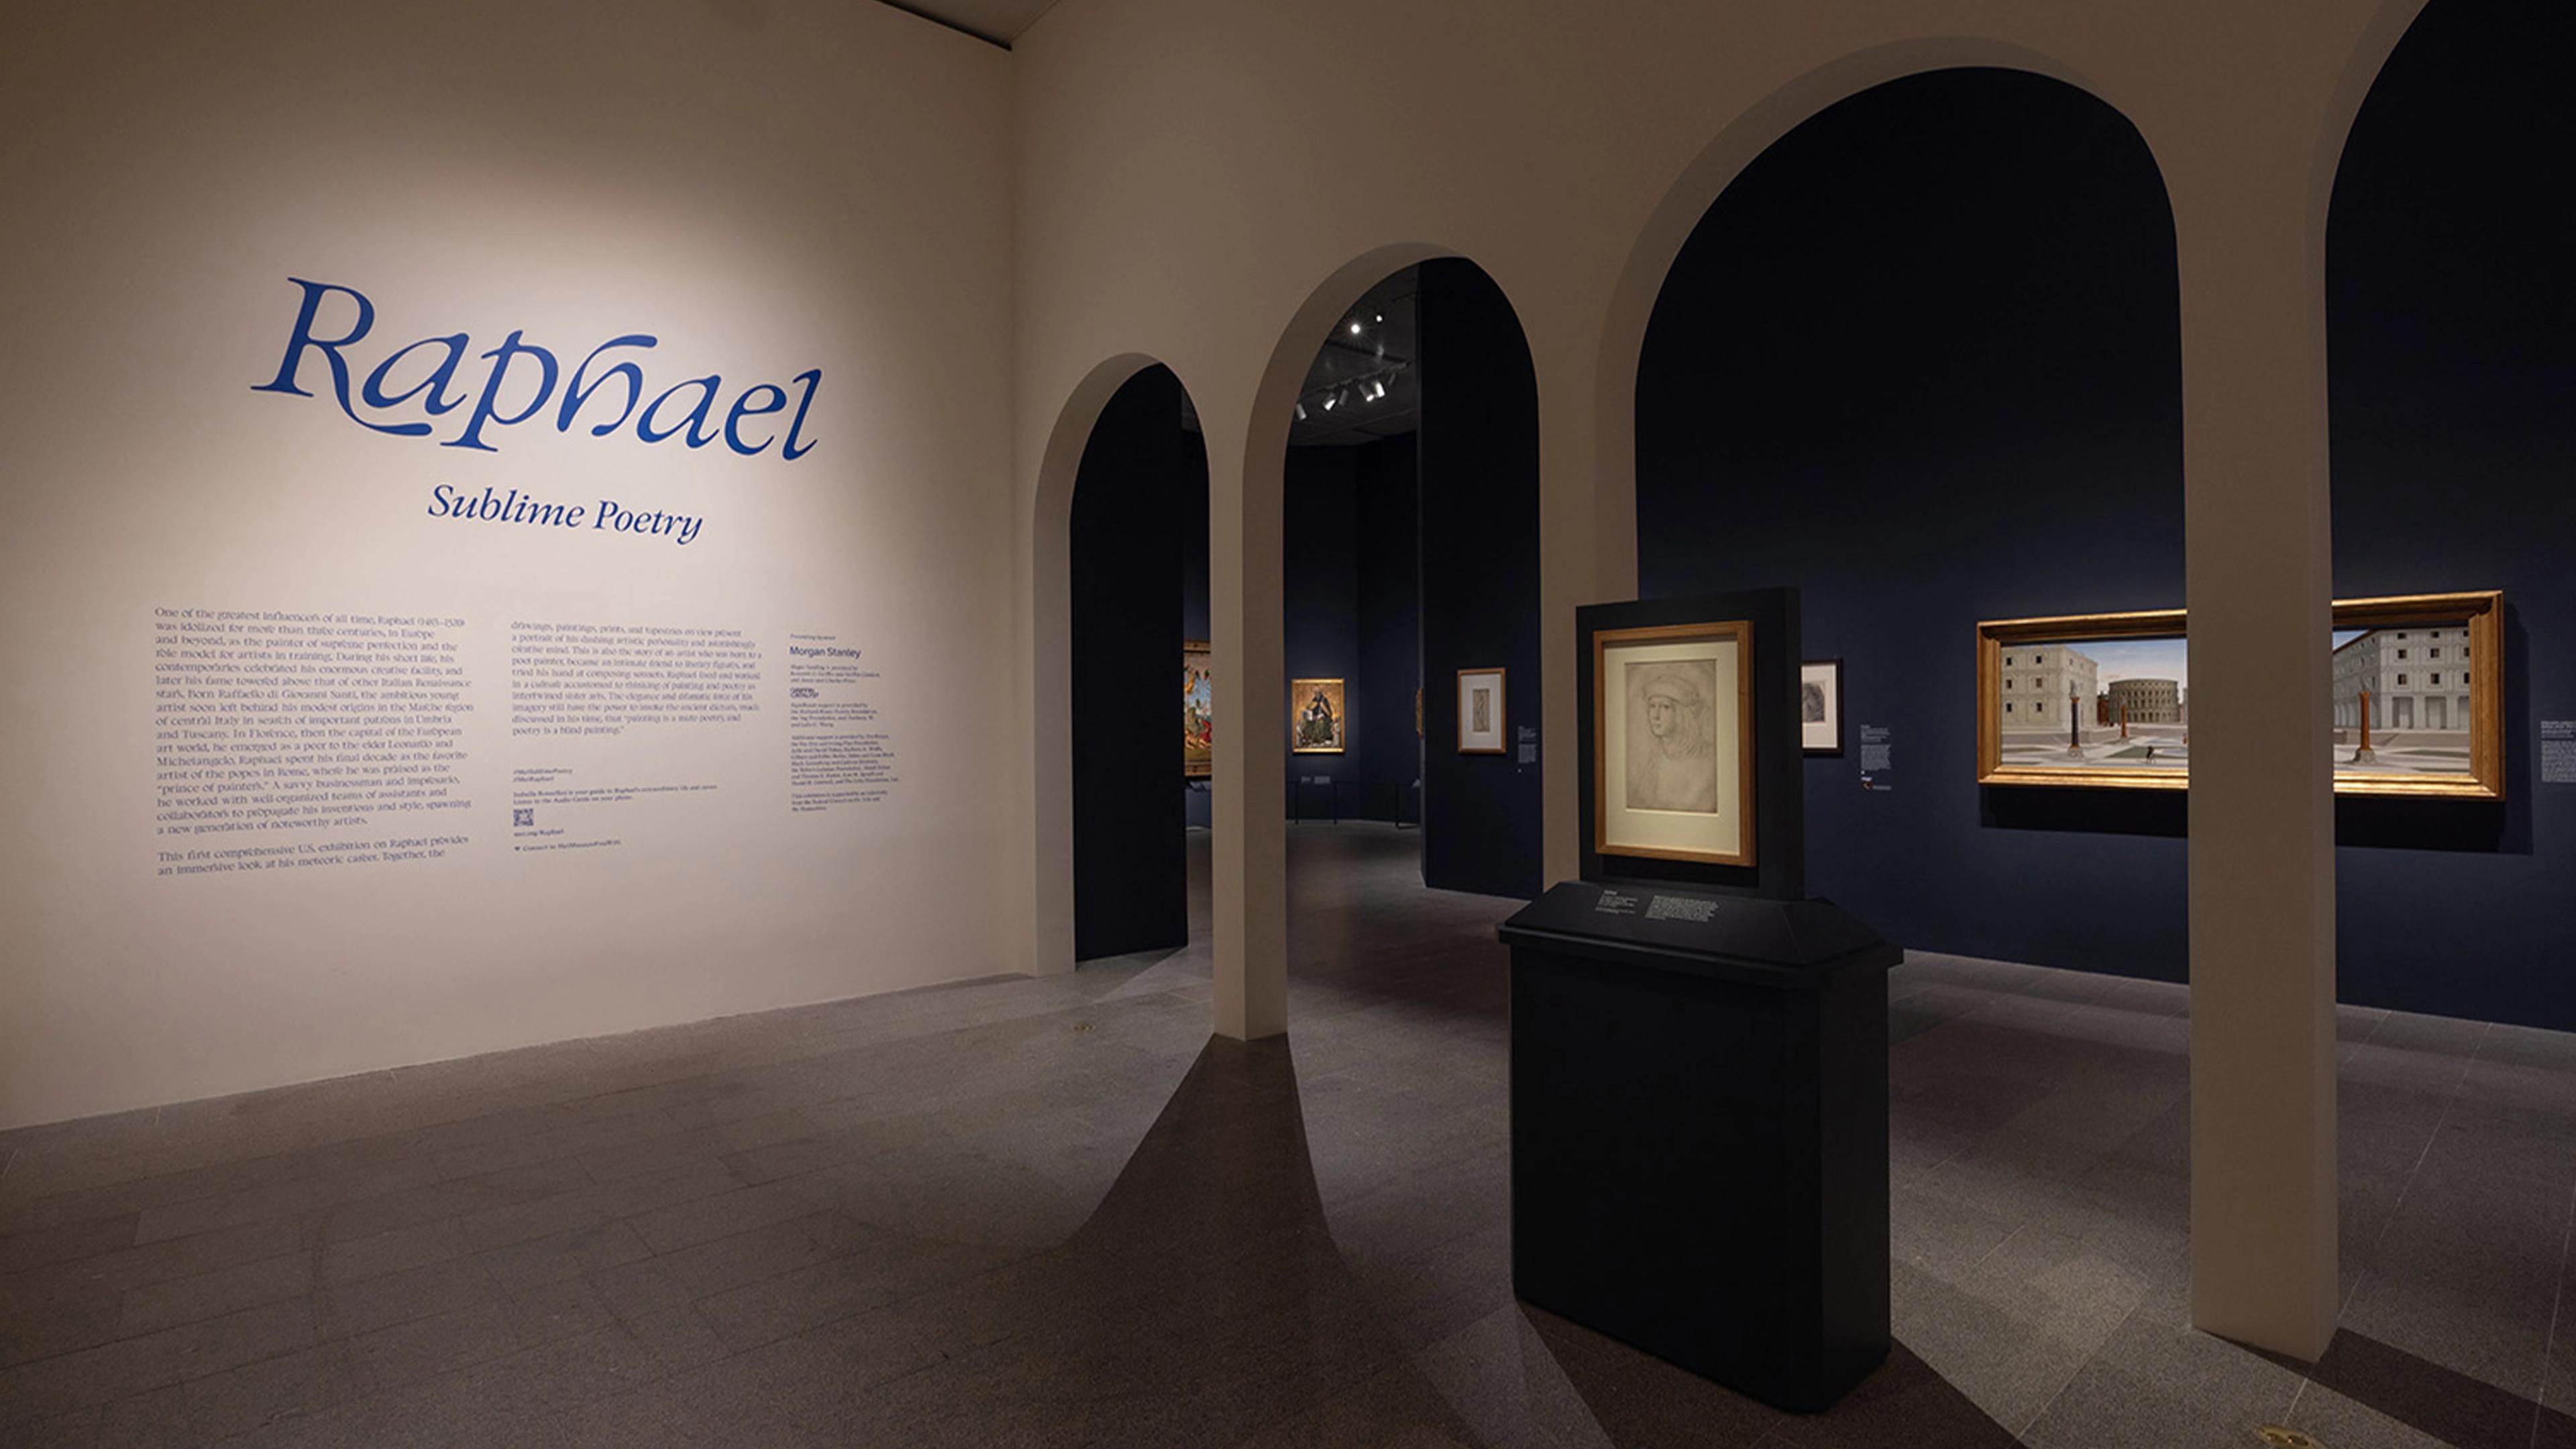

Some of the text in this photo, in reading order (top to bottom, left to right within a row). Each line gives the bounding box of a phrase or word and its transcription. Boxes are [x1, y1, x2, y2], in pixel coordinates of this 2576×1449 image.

[250, 276, 822, 461] Raphael
[428, 485, 703, 545] Sublime Poetry
[154, 607, 179, 616] One
[180, 608, 193, 617] of
[195, 608, 215, 617] the
[217, 610, 260, 620] greatest
[262, 610, 321, 621] influencers
[322, 612, 333, 621] of
[335, 612, 348, 622] all
[377, 614, 415, 625] Raphael
[180, 623, 225, 633] idolized
[228, 624, 244, 633] for
[278, 625, 303, 634] than
[307, 626, 334, 635] three
[388, 628, 398, 637] in
[400, 628, 435, 639] Europe
[155, 636, 178, 645] and
[244, 637, 262, 646] the
[266, 638, 304, 649] painter
[305, 639, 317, 647] of
[320, 641, 364, 650] supreme
[366, 640, 418, 651] perfection
[420, 641, 439, 650] and
[441, 641, 458, 650] the
[156, 649, 178, 657] role
[180, 649, 216, 658] model
[219, 650, 233, 659] for
[237, 650, 272, 659] artists
[274, 651, 287, 659] in
[335, 651, 373, 663] During
[374, 652, 390, 661] his
[393, 653, 418, 661] short
[439, 653, 454, 662] his
[790, 646, 861, 659] Morgan Stanley
[156, 676, 182, 685] later
[184, 676, 203, 685] his
[205, 676, 233, 685] fame
[235, 676, 278, 686] towered
[282, 677, 312, 686] above
[314, 677, 335, 686] that
[337, 677, 349, 686] of
[352, 677, 379, 686] other
[380, 678, 413, 686] Italian
[187, 690, 215, 698] Born
[266, 690, 279, 698] di
[360, 690, 377, 699] the
[380, 690, 428, 699] ambitious
[156, 703, 186, 712] artist
[219, 703, 237, 712] left
[240, 703, 279, 712] behind
[281, 703, 298, 712] his
[300, 703, 337, 712] modest
[339, 703, 375, 714] origins
[377, 703, 388, 712] in
[389, 703, 407, 712] the
[154, 716, 168, 725] of
[169, 716, 212, 725] central
[214, 716, 239, 727] Italy
[241, 716, 254, 724] in
[257, 716, 292, 724] search
[294, 716, 306, 724] of
[309, 716, 360, 727] important
[363, 715, 401, 727] patrons
[402, 715, 415, 724] in
[157, 730, 179, 739] and
[233, 729, 247, 738] In
[300, 729, 326, 737] then
[327, 728, 345, 737] the
[348, 727, 382, 739] capital
[385, 727, 396, 736] of
[397, 727, 415, 736] the
[417, 727, 462, 737] European
[201, 782, 214, 792] of
[272, 781, 280, 790] A
[283, 782, 314, 791] savvy
[315, 780, 382, 788] businessman
[384, 777, 405, 787] and
[156, 797, 172, 806] he
[176, 795, 218, 805] worked
[222, 794, 248, 804] with
[331, 791, 363, 800] teams
[365, 790, 376, 799] of
[378, 788, 426, 798] assistants
[428, 788, 447, 796] and
[194, 822, 254, 835] generation
[256, 821, 268, 830] of
[270, 819, 329, 830] noteworthy
[160, 851, 183, 860] This
[187, 849, 211, 859] first
[213, 845, 294, 858] comprehensive
[318, 841, 371, 852] exhibition
[389, 838, 428, 849] Raphael
[429, 836, 468, 848] provides
[176, 863, 235, 873] immersive
[237, 860, 262, 870] look
[265, 859, 276, 868] at
[278, 859, 295, 867] his
[297, 856, 343, 867] meteoric
[428, 850, 445, 859] the
